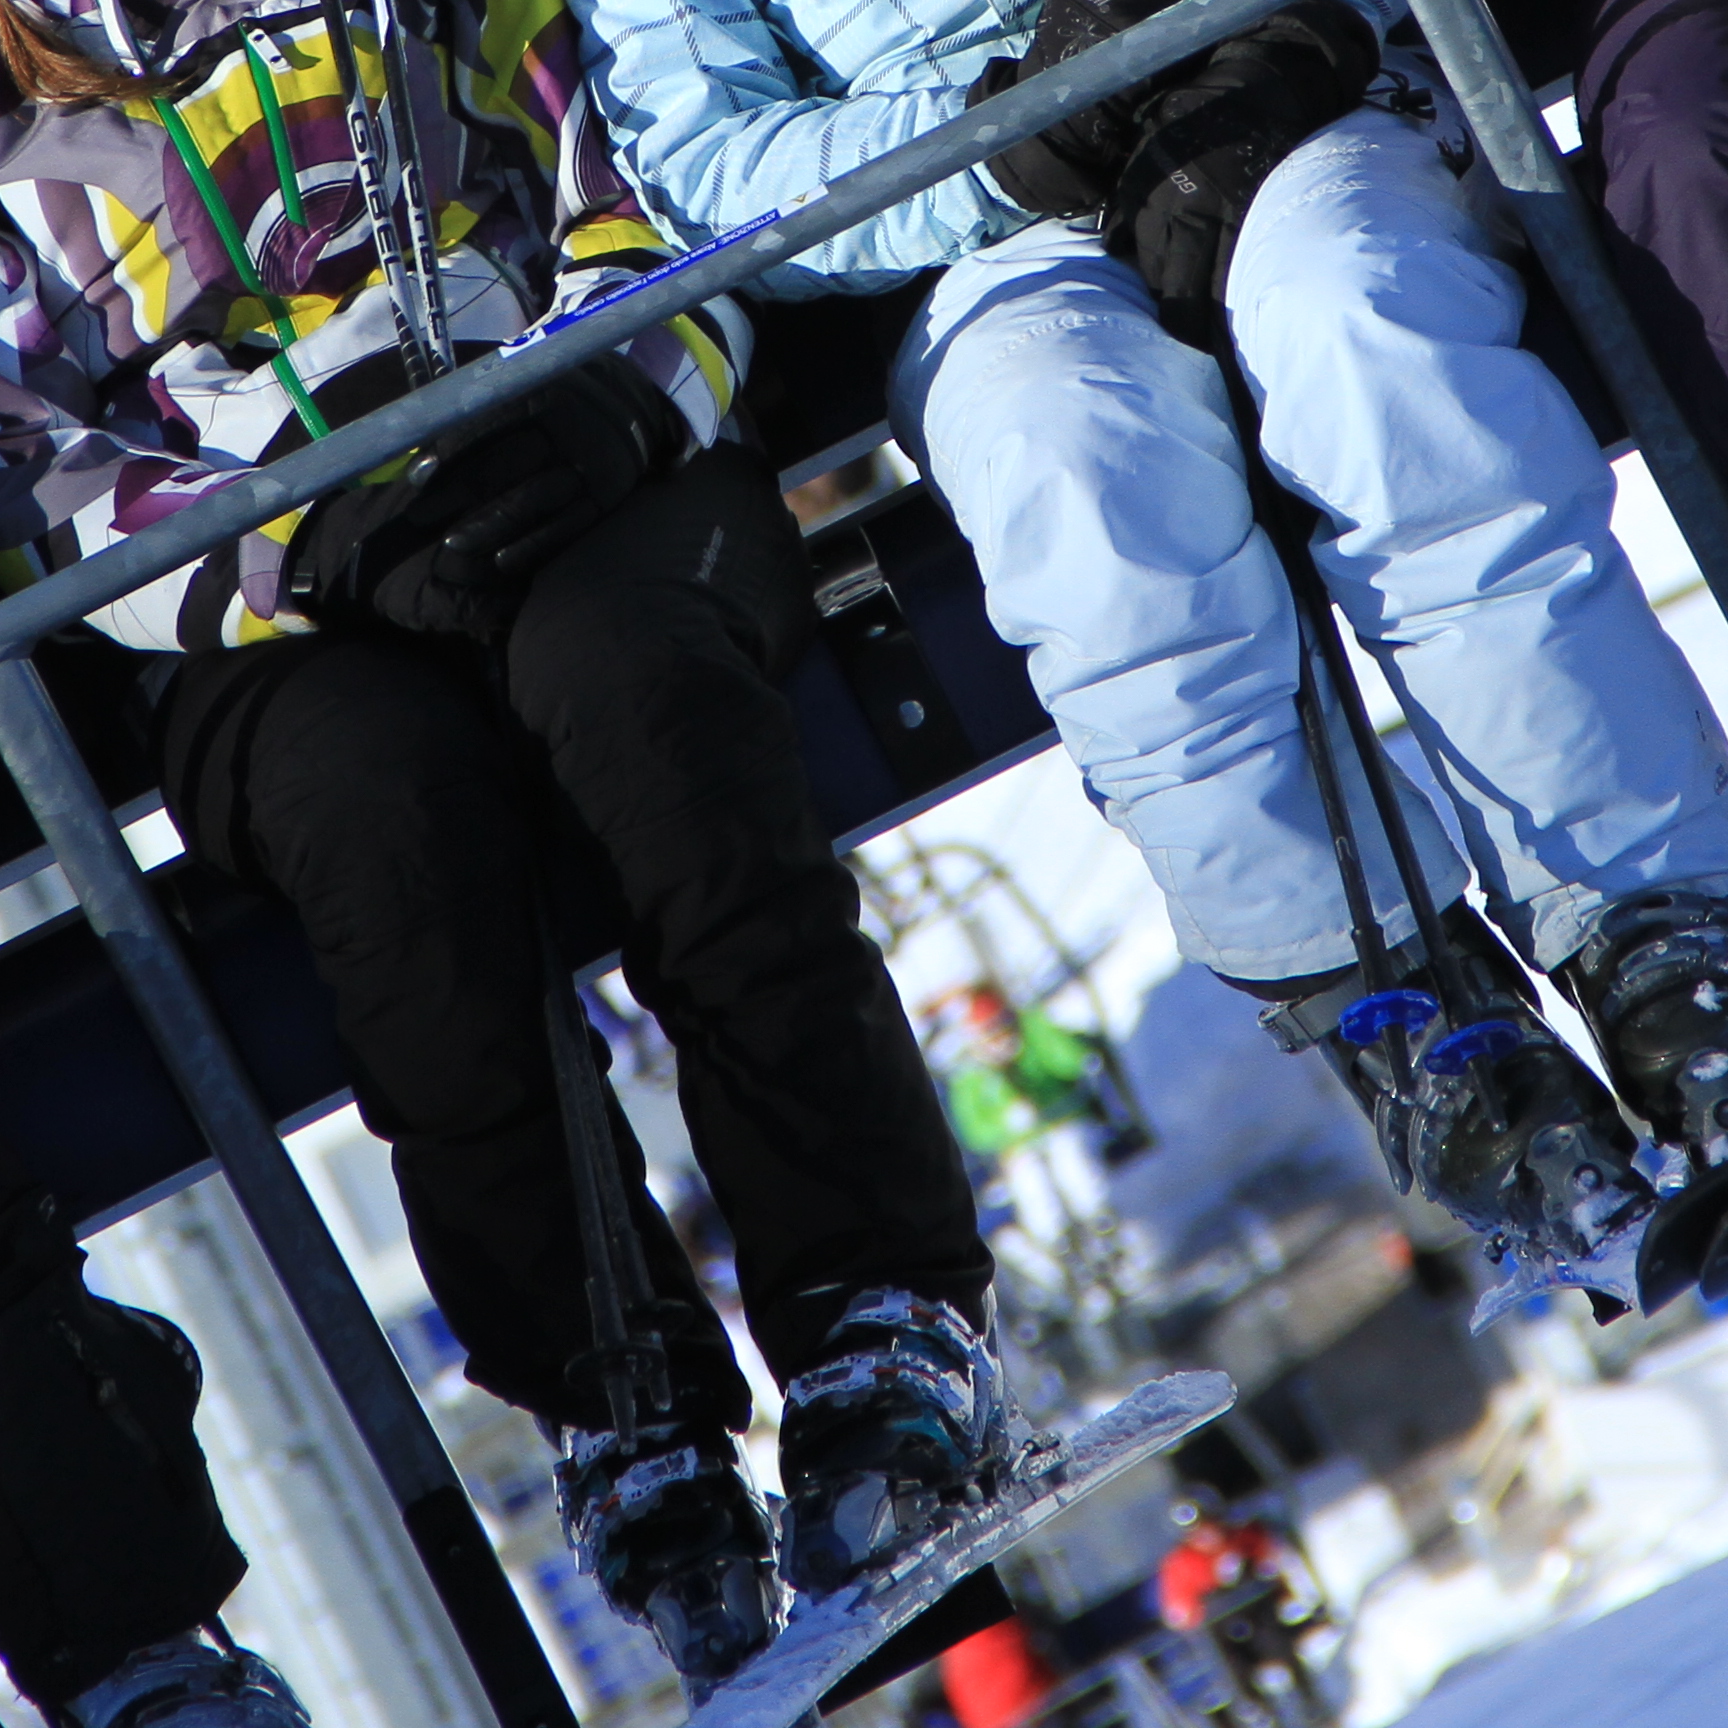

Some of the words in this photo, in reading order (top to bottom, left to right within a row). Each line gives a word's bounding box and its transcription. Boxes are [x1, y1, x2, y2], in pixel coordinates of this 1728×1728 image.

[350, 110, 402, 286] GABEL
[670, 255, 691, 270] solo
[646, 265, 671, 280] dopo
